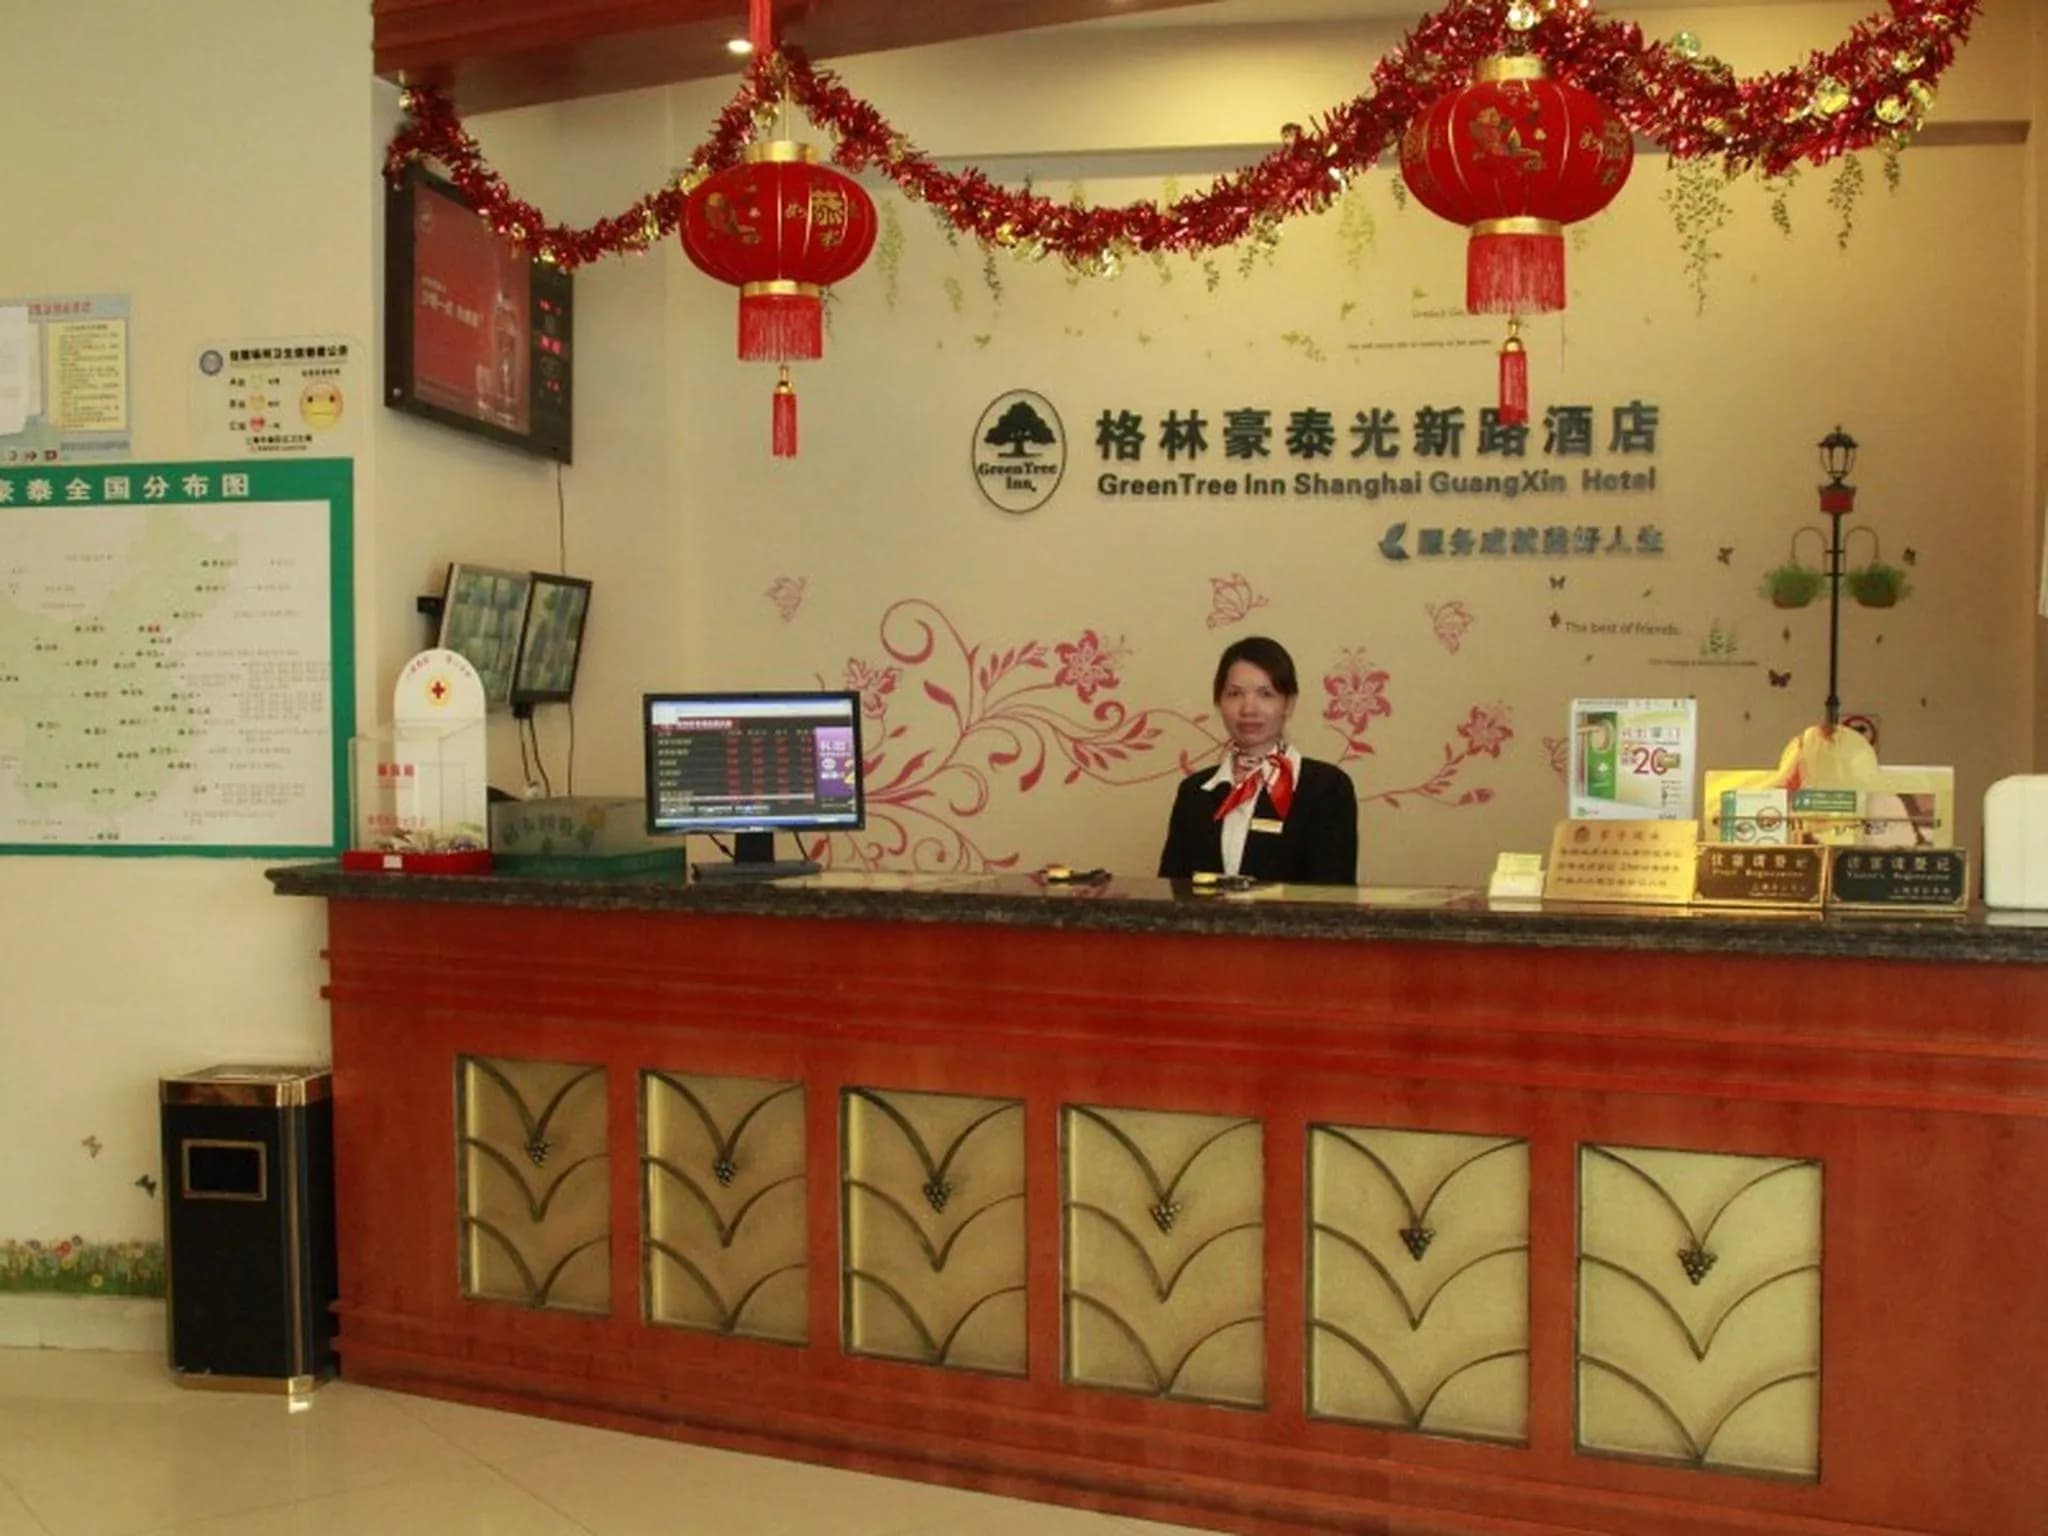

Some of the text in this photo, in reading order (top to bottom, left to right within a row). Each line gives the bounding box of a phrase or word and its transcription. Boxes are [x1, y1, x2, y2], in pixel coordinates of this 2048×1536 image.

[1096, 400, 1659, 461] 格林豪泰光新路酒店
[978, 462, 1057, 475] GreenTree
[1098, 466, 1656, 499] GreenTree Inn Shanghai GuangXin Hotel
